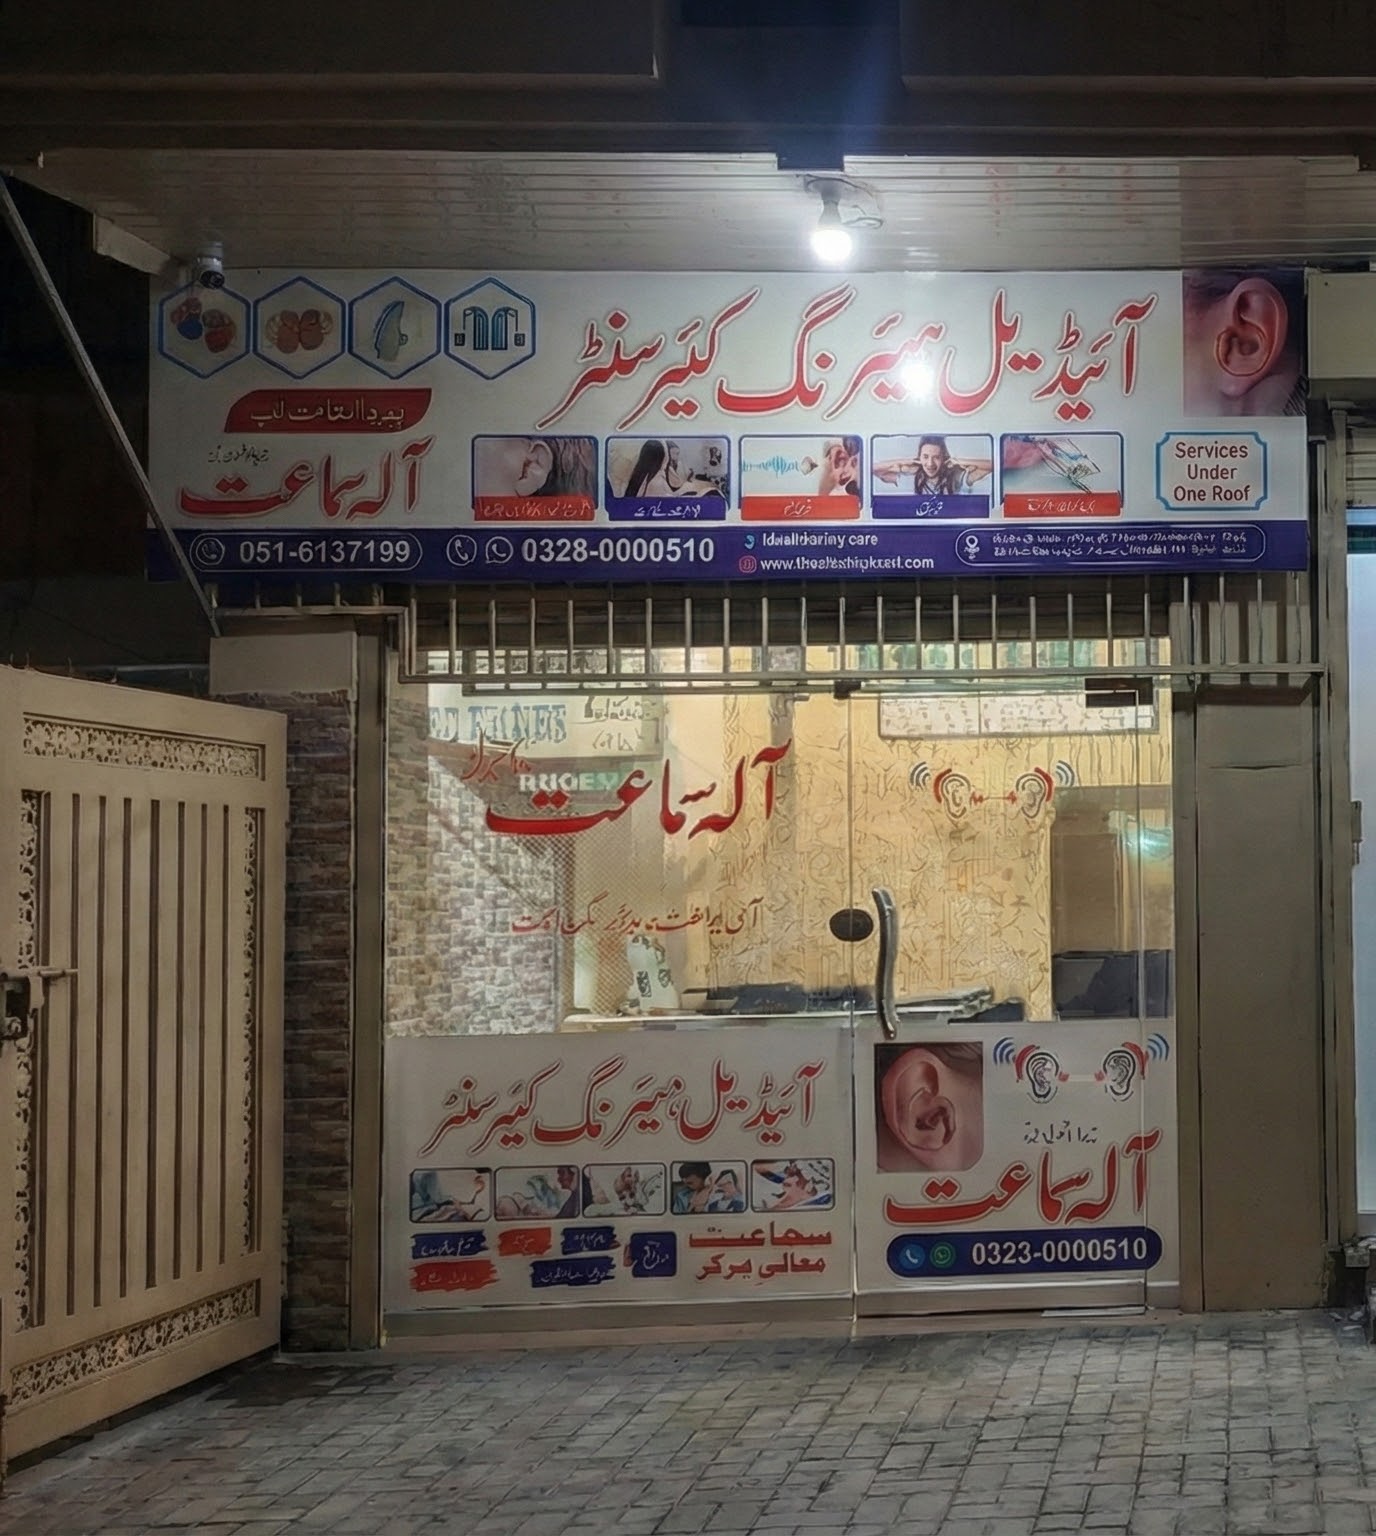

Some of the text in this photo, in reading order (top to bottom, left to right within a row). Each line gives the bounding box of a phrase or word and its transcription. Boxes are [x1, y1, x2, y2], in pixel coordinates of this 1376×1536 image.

[1175, 441, 1248, 458] Services
[1187, 464, 1237, 479] Under
[1174, 485, 1250, 501] One Roof
[849, 535, 879, 546] care
[239, 539, 410, 564] 051-6137199
[522, 537, 715, 563] 0328-0000510
[972, 1238, 1148, 1266] 0323-0000510
